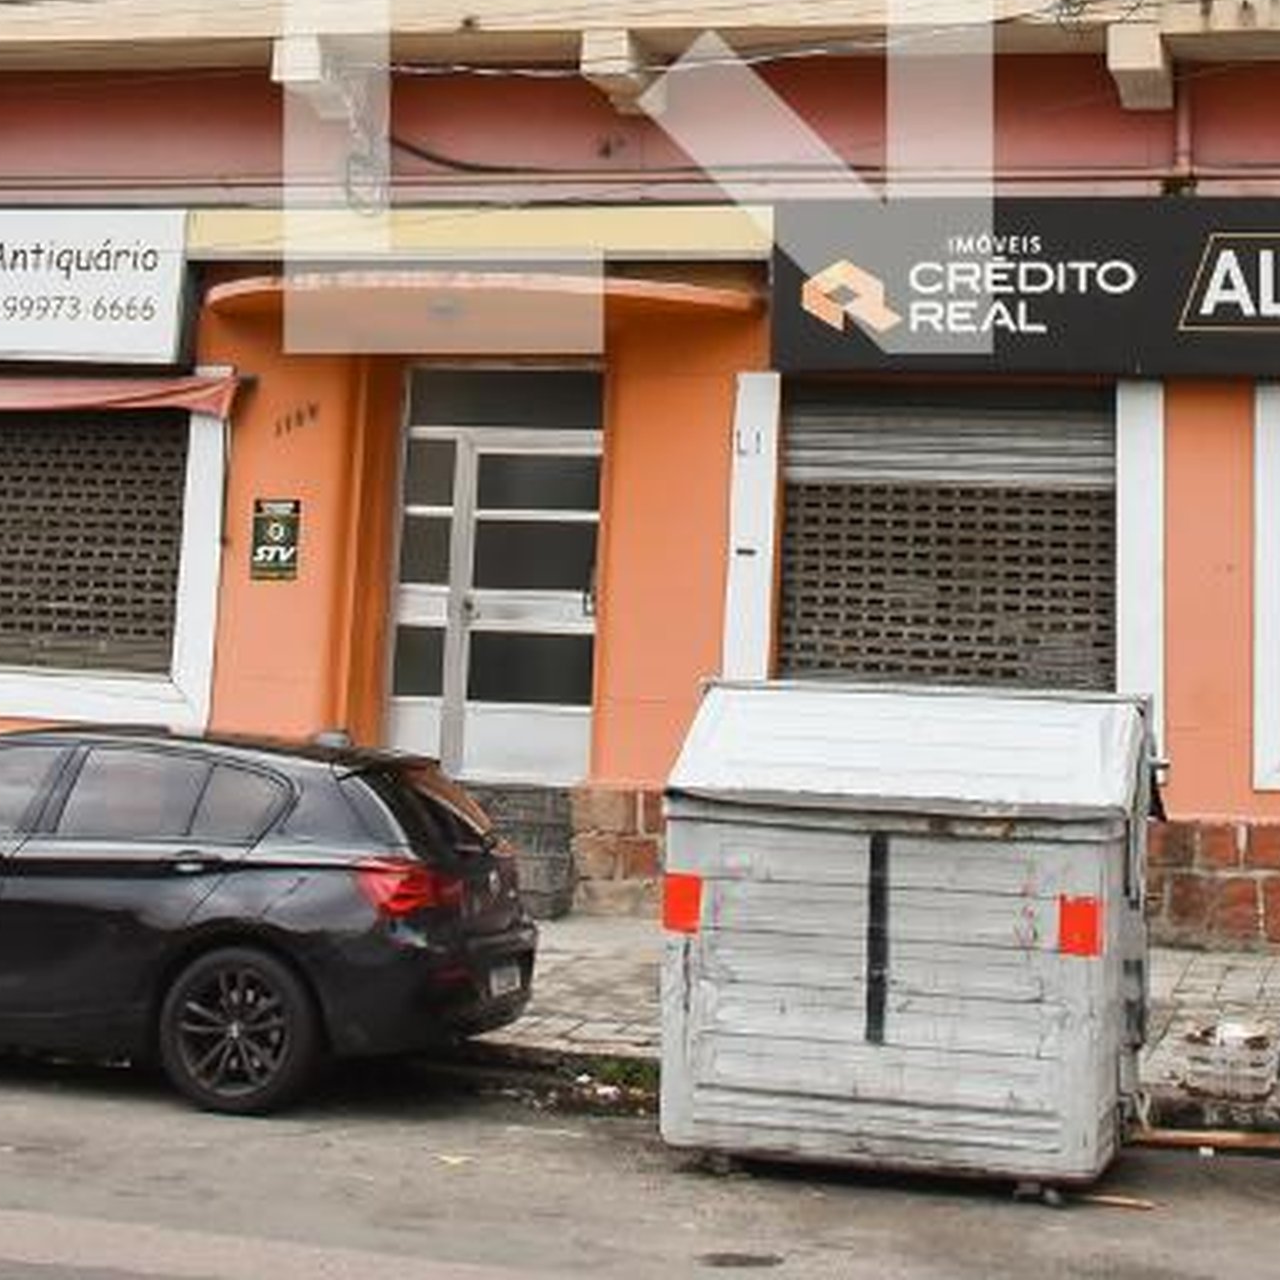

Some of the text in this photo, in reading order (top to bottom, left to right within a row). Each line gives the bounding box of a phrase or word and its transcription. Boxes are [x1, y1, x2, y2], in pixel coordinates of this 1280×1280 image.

[909, 255, 1138, 293] CRÉDITO
[909, 301, 1048, 333] REAL
[252, 545, 297, 562] STV
